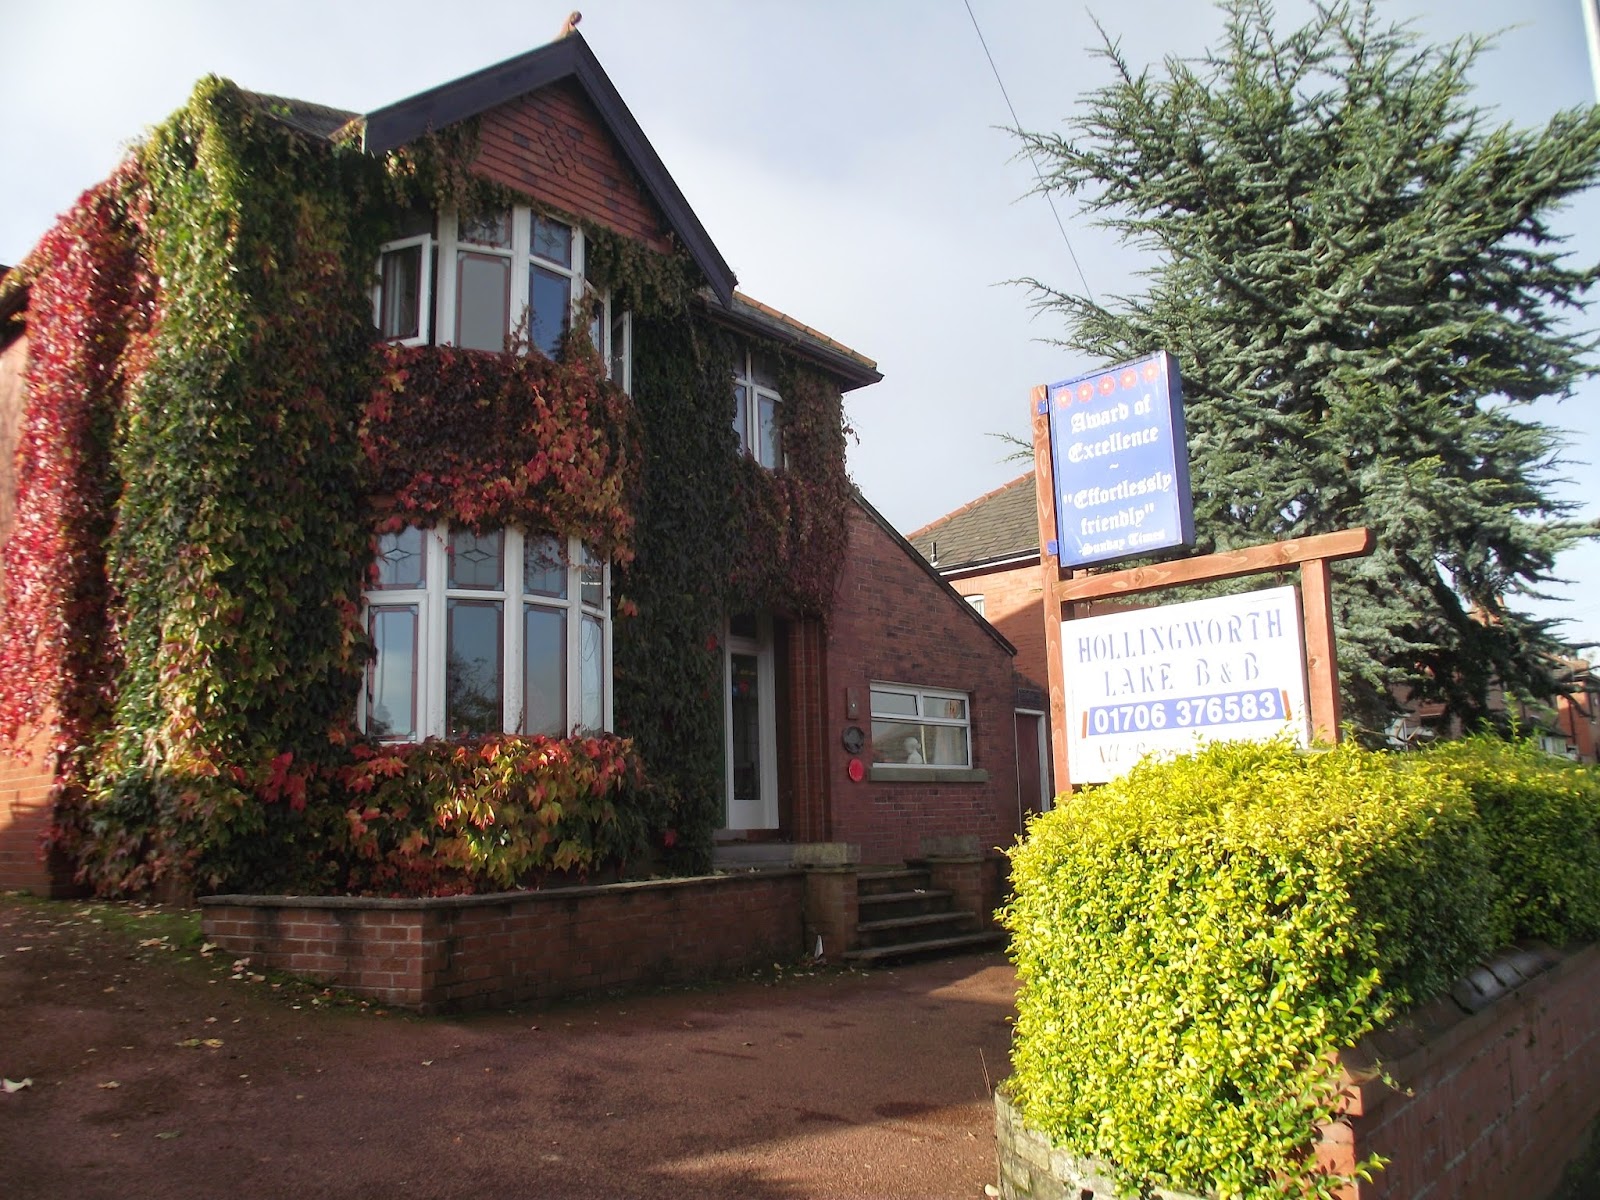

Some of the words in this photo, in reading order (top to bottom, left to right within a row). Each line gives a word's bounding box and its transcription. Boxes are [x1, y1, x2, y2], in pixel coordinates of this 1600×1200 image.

[1070, 402, 1129, 435] Award
[1134, 393, 1151, 416] of
[1068, 426, 1159, 463] Excellence
[1078, 608, 1283, 663] HOLLINGWORTH
[1104, 662, 1174, 697] LAKE
[1195, 658, 1210, 687] B
[1220, 663, 1232, 684] &
[1244, 652, 1260, 681] B
[1094, 702, 1167, 733] 01706
[1176, 691, 1276, 726] 376583
